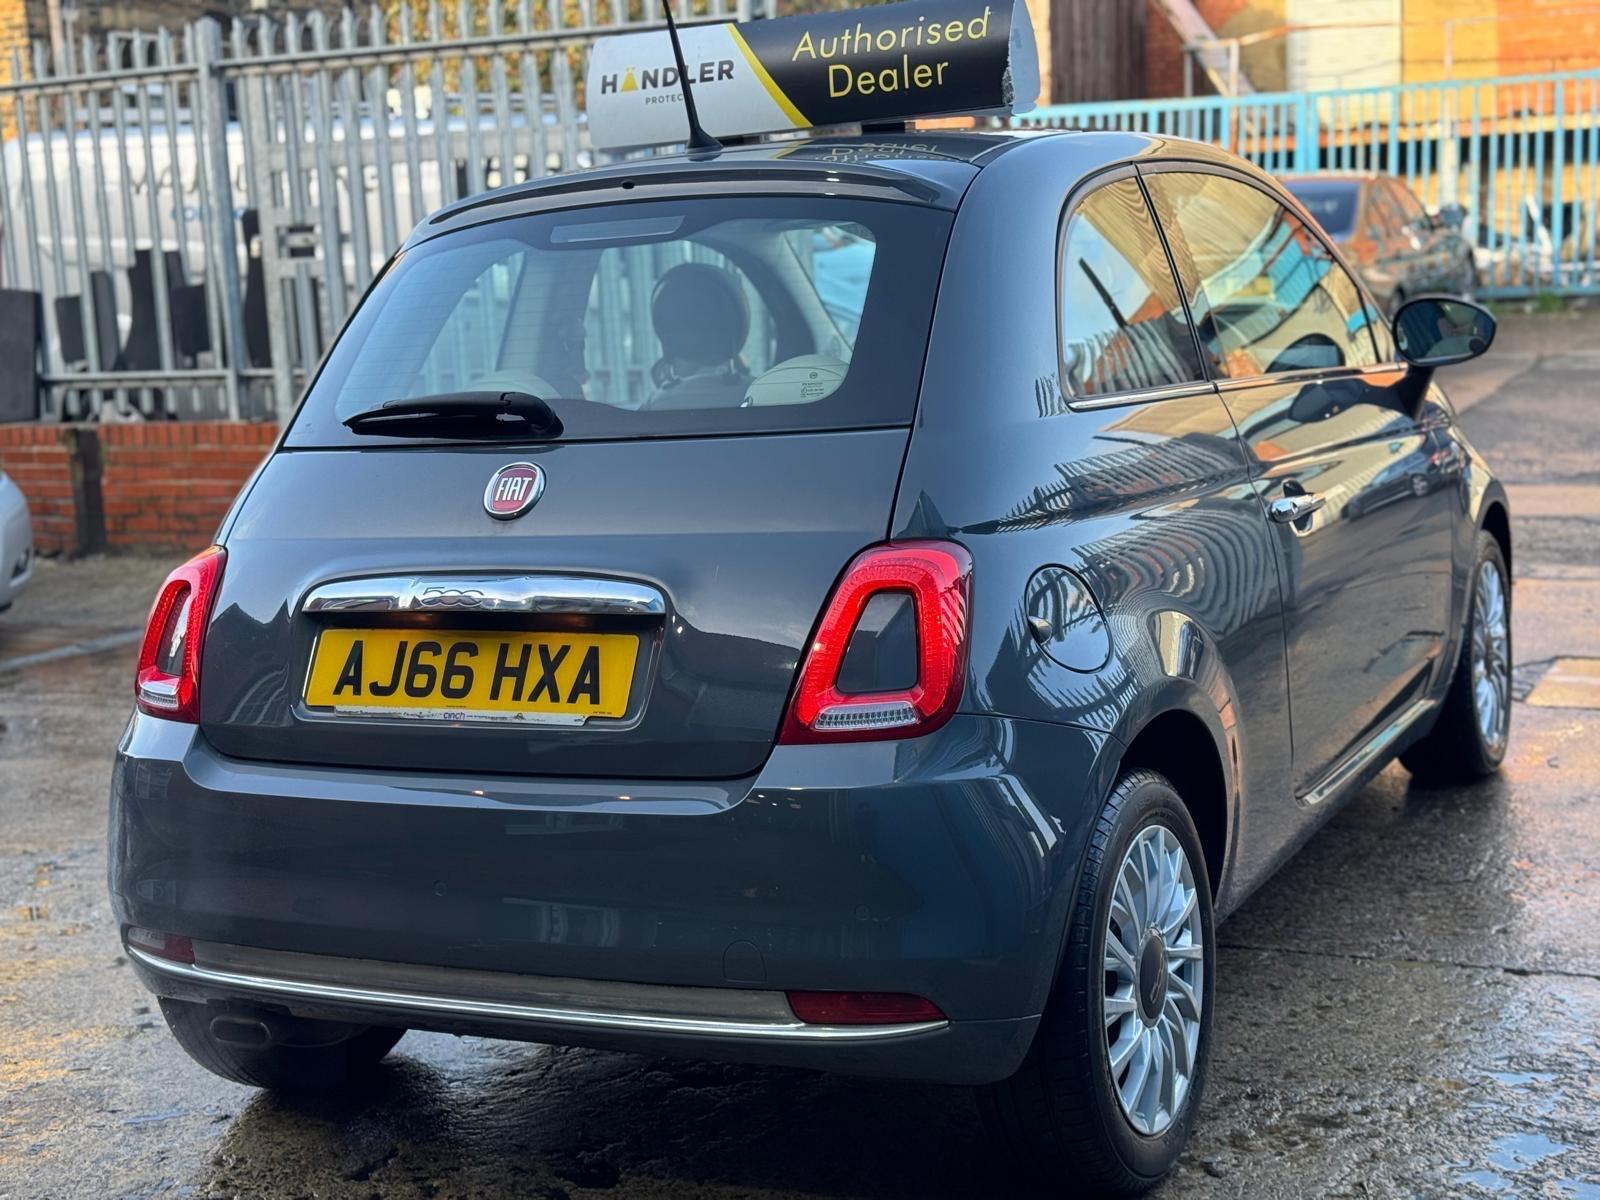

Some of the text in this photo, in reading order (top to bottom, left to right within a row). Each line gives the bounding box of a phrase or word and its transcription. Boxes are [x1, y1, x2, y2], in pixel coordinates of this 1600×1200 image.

[792, 6, 990, 62] Authorised
[829, 54, 949, 98] Dealer
[645, 93, 685, 104] PROTEC
[495, 477, 533, 501] FIAT
[421, 587, 484, 607] 500
[333, 640, 601, 705] AJ66 HXA
[443, 712, 466, 720] cinch
